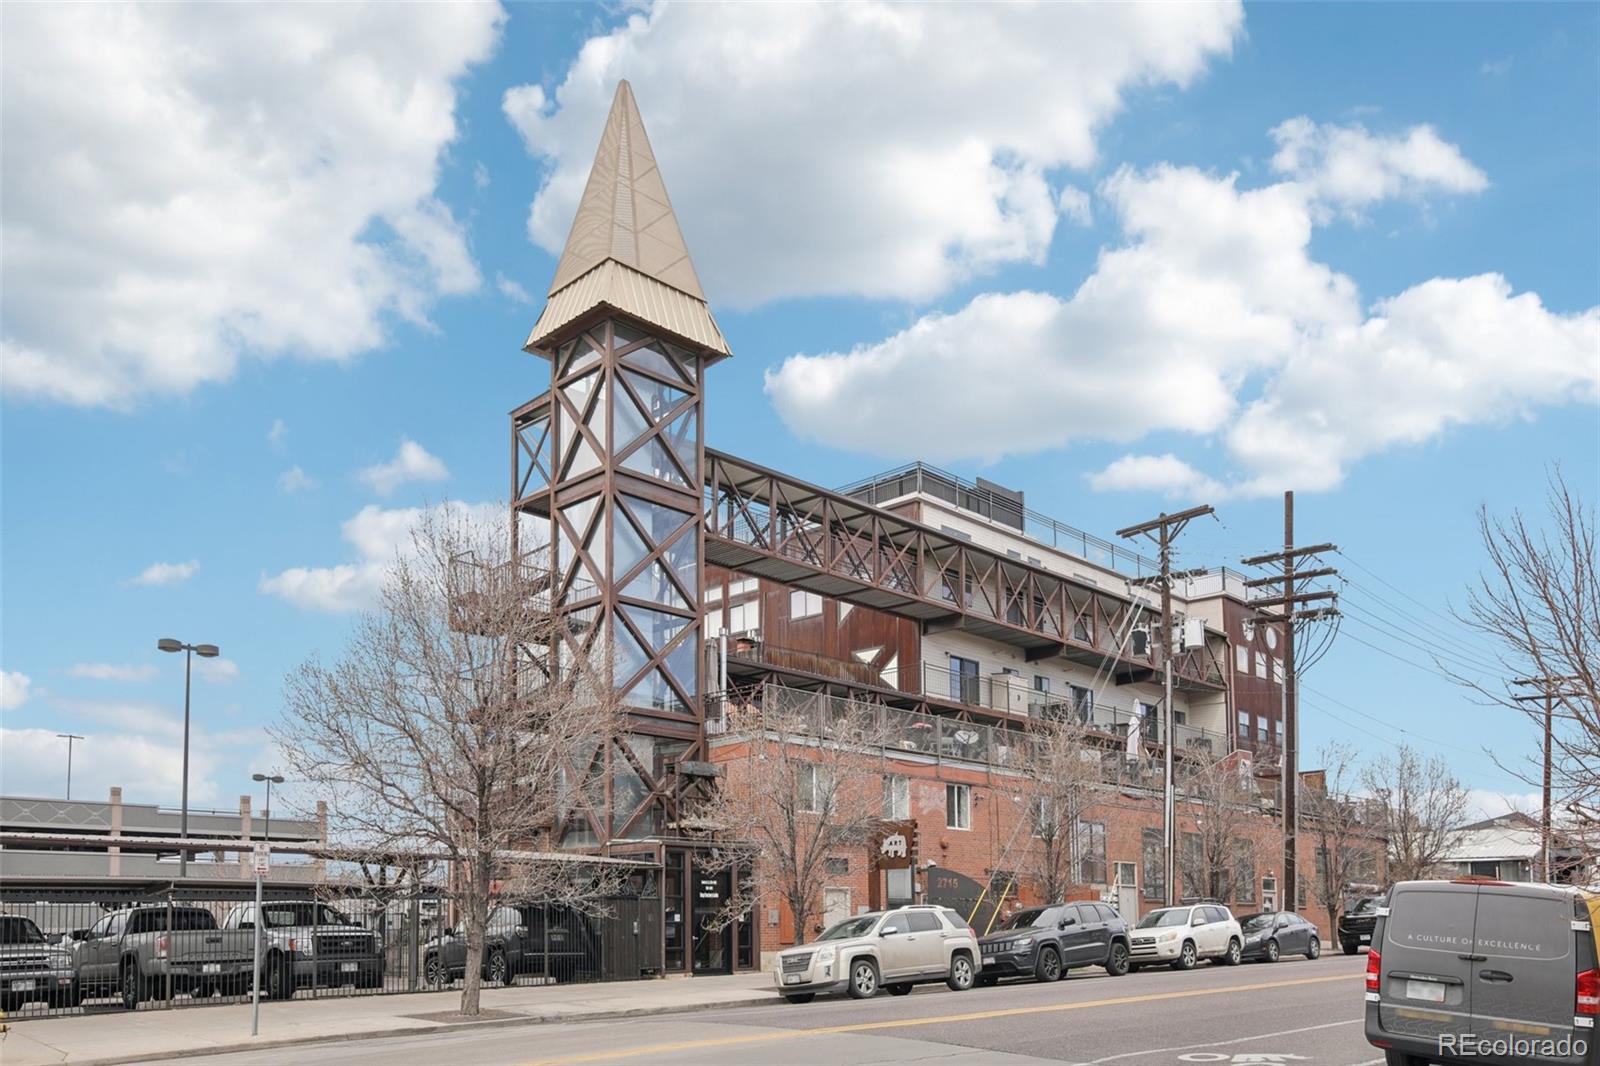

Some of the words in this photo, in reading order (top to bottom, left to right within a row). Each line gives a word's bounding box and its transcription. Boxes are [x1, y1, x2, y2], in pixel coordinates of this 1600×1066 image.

[937, 877, 959, 889] 2715
[1416, 934, 1458, 945] CULTURE
[1478, 939, 1541, 951] EXCELLENCE
